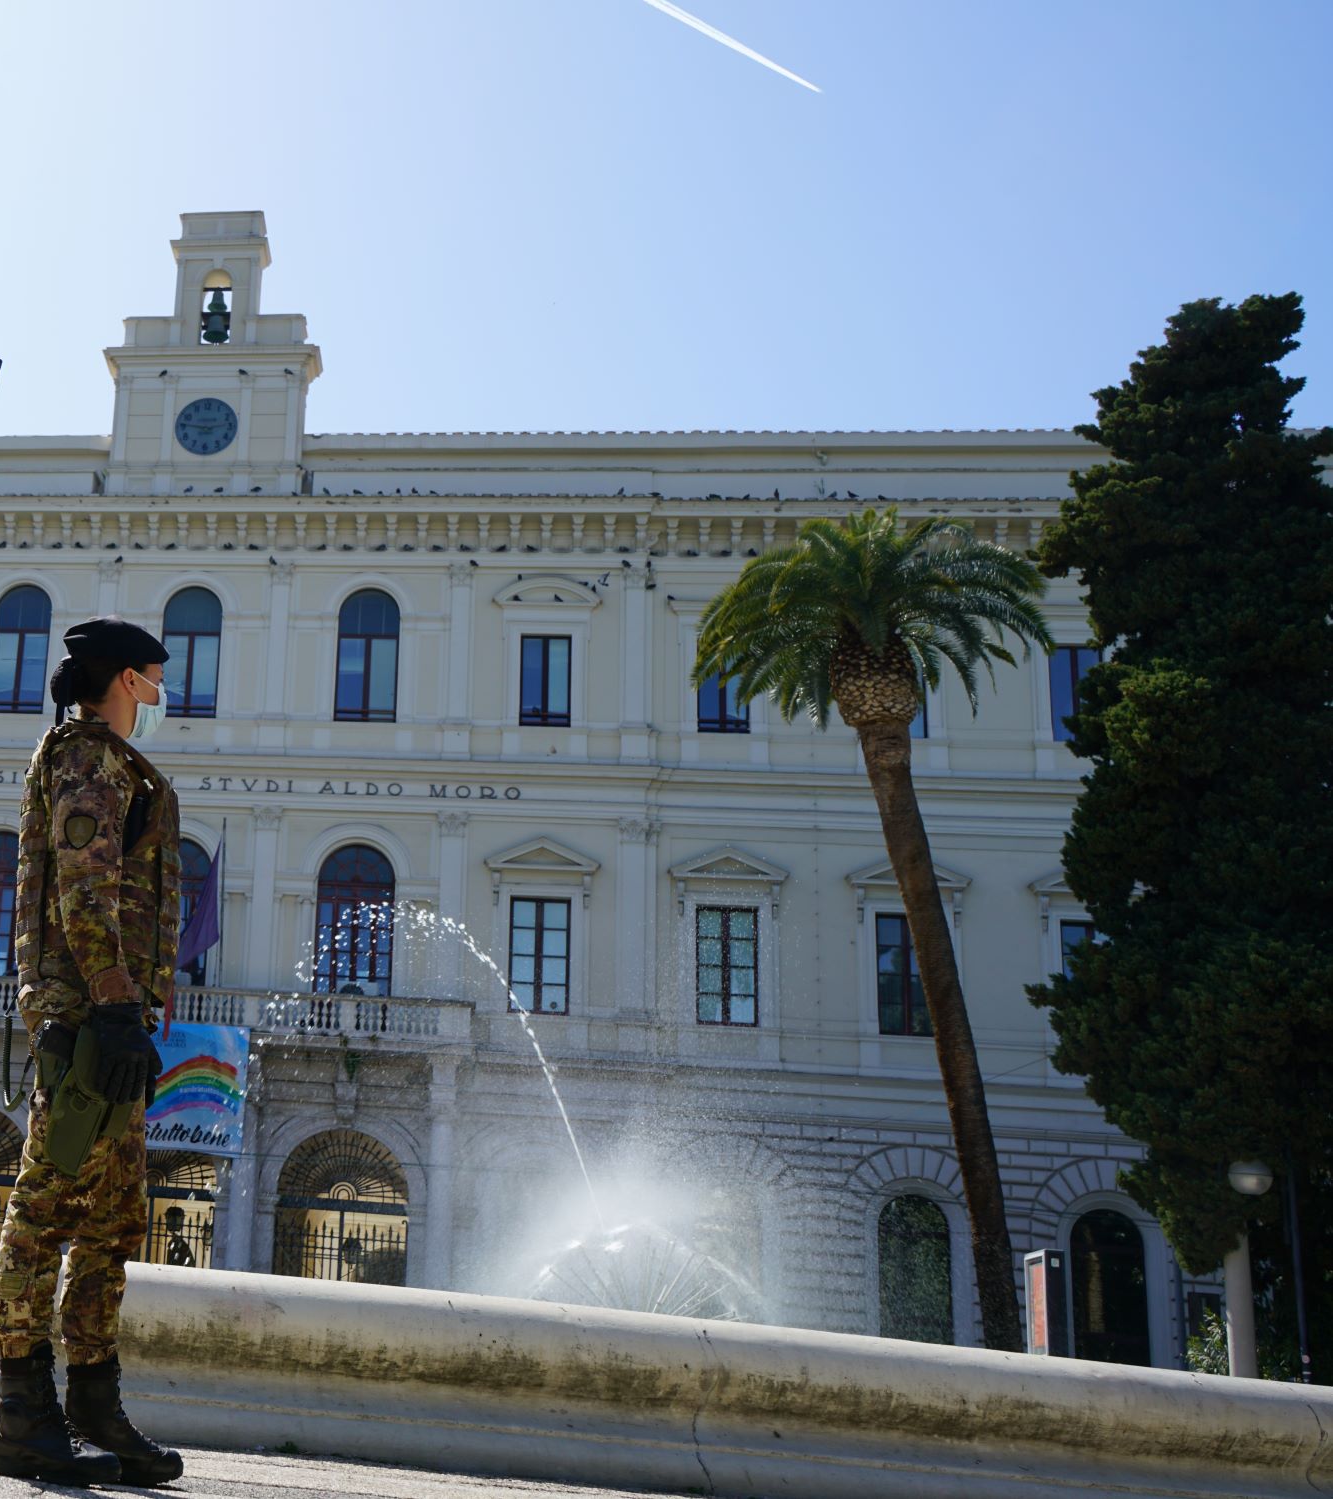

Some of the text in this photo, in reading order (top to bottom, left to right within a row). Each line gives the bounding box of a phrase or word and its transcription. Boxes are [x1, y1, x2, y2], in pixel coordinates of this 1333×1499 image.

[198, 777, 295, 793] STVDI
[318, 781, 403, 797] ALDO
[428, 783, 522, 800] MORO
